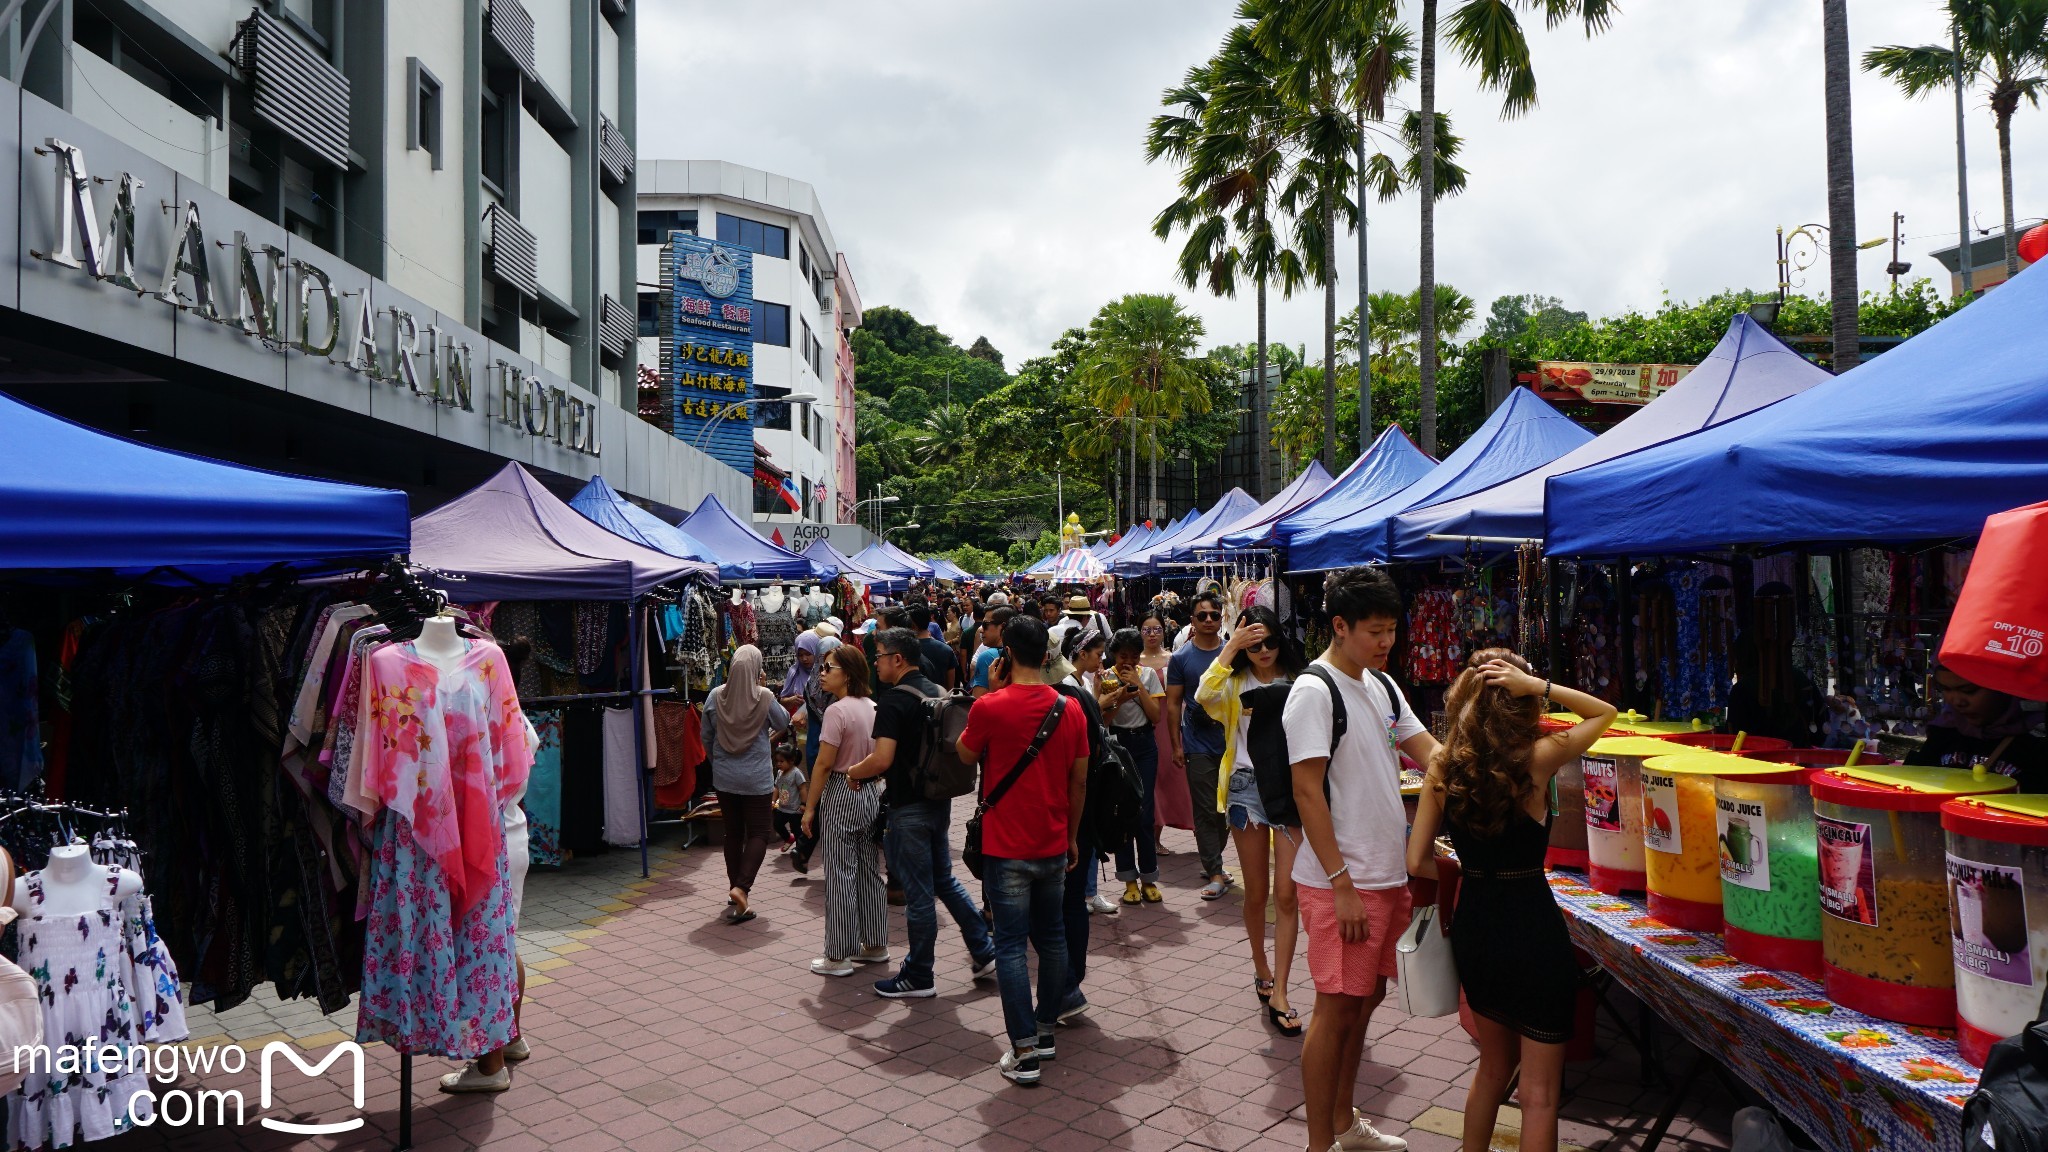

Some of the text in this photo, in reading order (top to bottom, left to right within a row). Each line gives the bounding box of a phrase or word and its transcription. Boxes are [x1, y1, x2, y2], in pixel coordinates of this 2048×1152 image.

[44, 137, 601, 458] MANDARIN HOTEL
[681, 315, 751, 333] Seafood Restaurant
[1595, 368, 1636, 376] 29/9/2018
[682, 372, 748, 394] 山打根海魚
[793, 526, 830, 539] AGRO
[1994, 621, 2045, 640] DRY TUBE
[2006, 634, 2044, 657] 10
[1586, 760, 1614, 778] FRUITS
[1650, 775, 1674, 788] JUICE
[1737, 803, 1762, 817] JUICE
[1823, 825, 1861, 844] CINCAU
[1982, 868, 2014, 890] MILK
[1825, 887, 1858, 906] (SMALL)
[1826, 899, 1844, 914] (BIG)
[1964, 940, 2011, 965] (SMALL)
[1965, 955, 1991, 974] (BIG)
